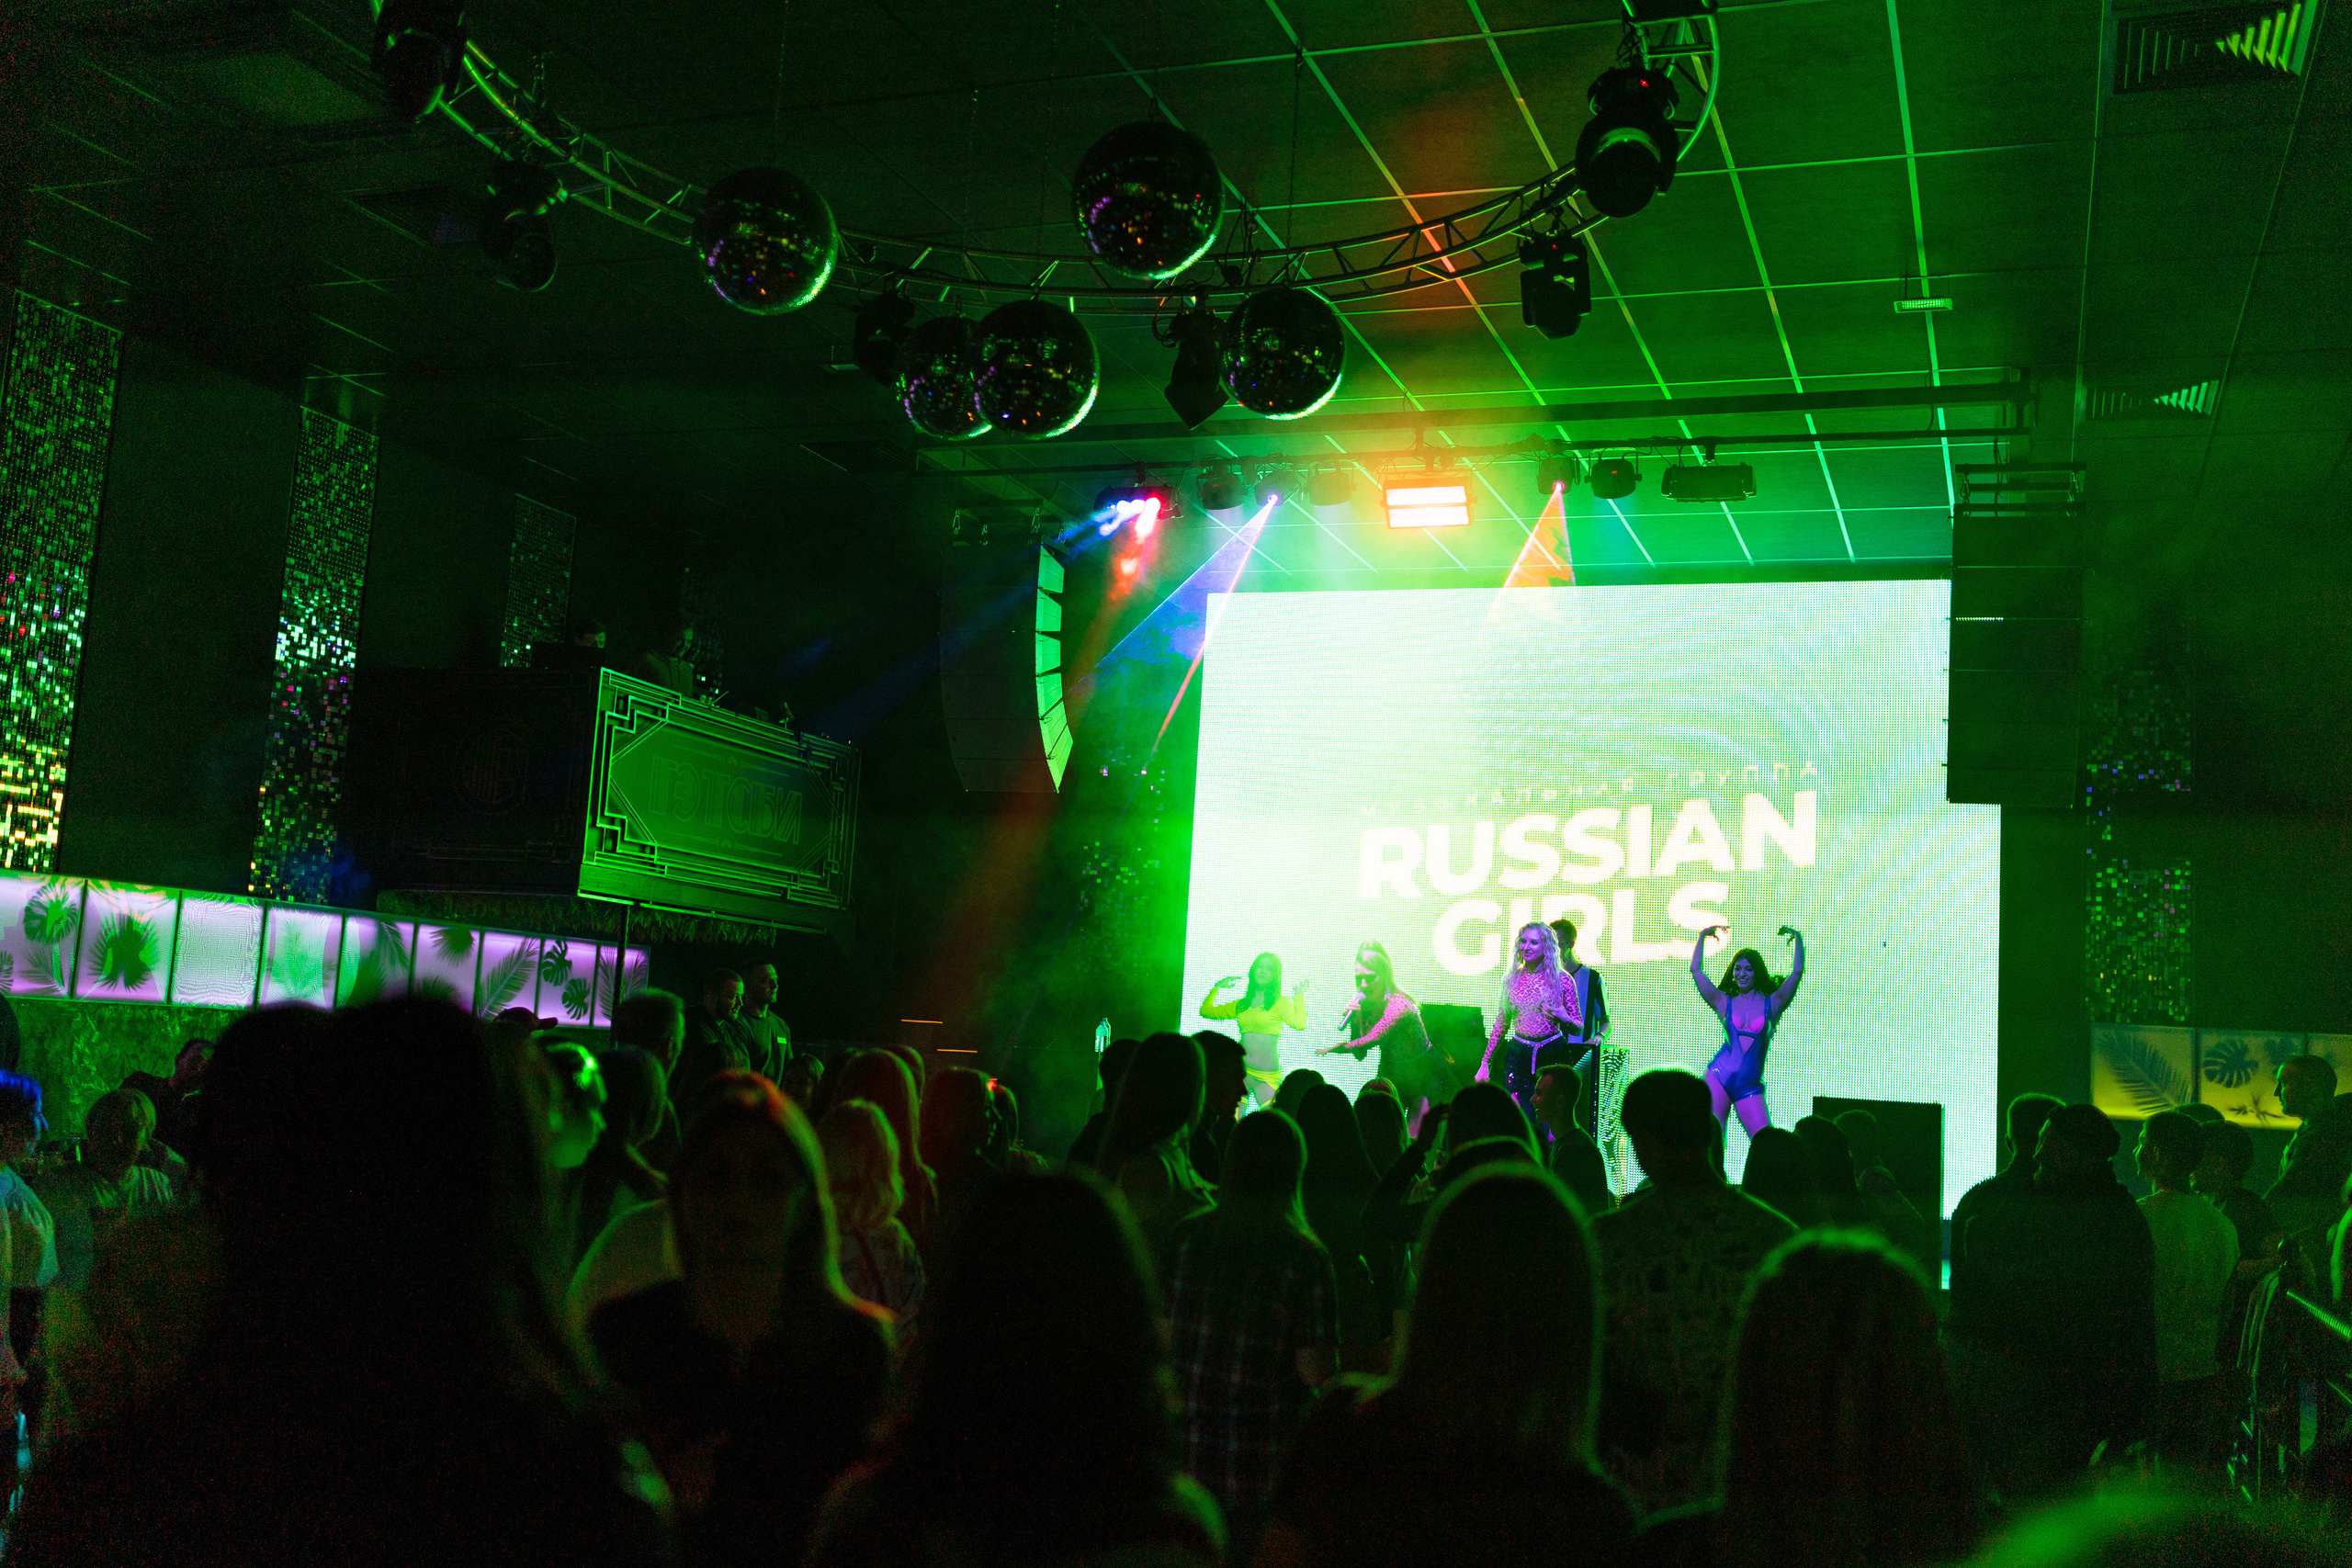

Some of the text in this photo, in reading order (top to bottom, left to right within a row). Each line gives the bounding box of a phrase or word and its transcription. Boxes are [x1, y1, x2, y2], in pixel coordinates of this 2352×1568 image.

[648, 755, 804, 845] ГЭТСБИ
[1665, 761, 1818, 790] ГРУППА
[1358, 790, 1818, 899] RUSSIAN
